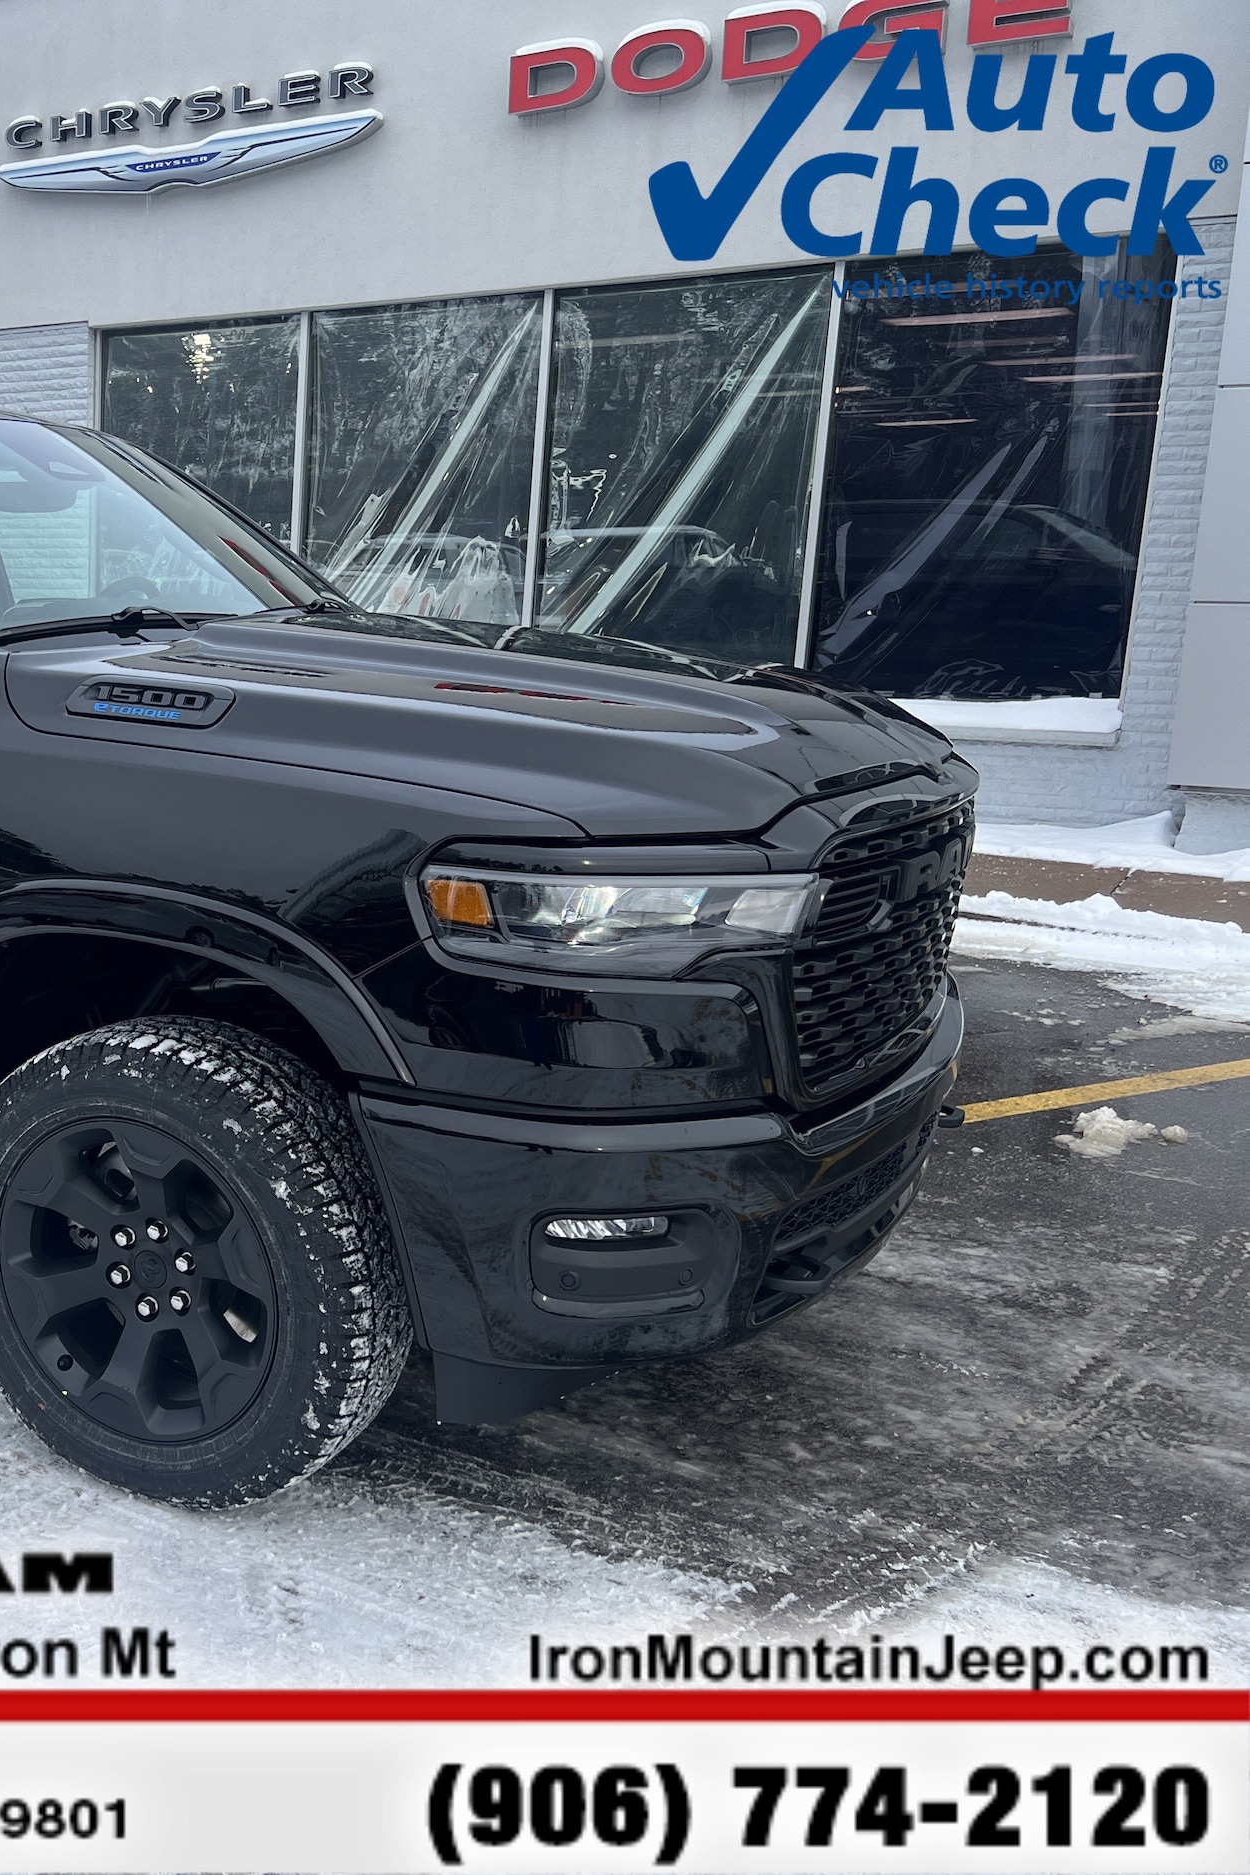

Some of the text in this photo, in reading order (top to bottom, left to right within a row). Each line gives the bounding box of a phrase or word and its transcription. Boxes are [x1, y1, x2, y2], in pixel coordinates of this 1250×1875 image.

[509, 0, 1070, 115] DODGE
[4, 64, 374, 150] CHRYSLER
[135, 155, 209, 171] CHRYSLER
[93, 685, 207, 710] 1500
